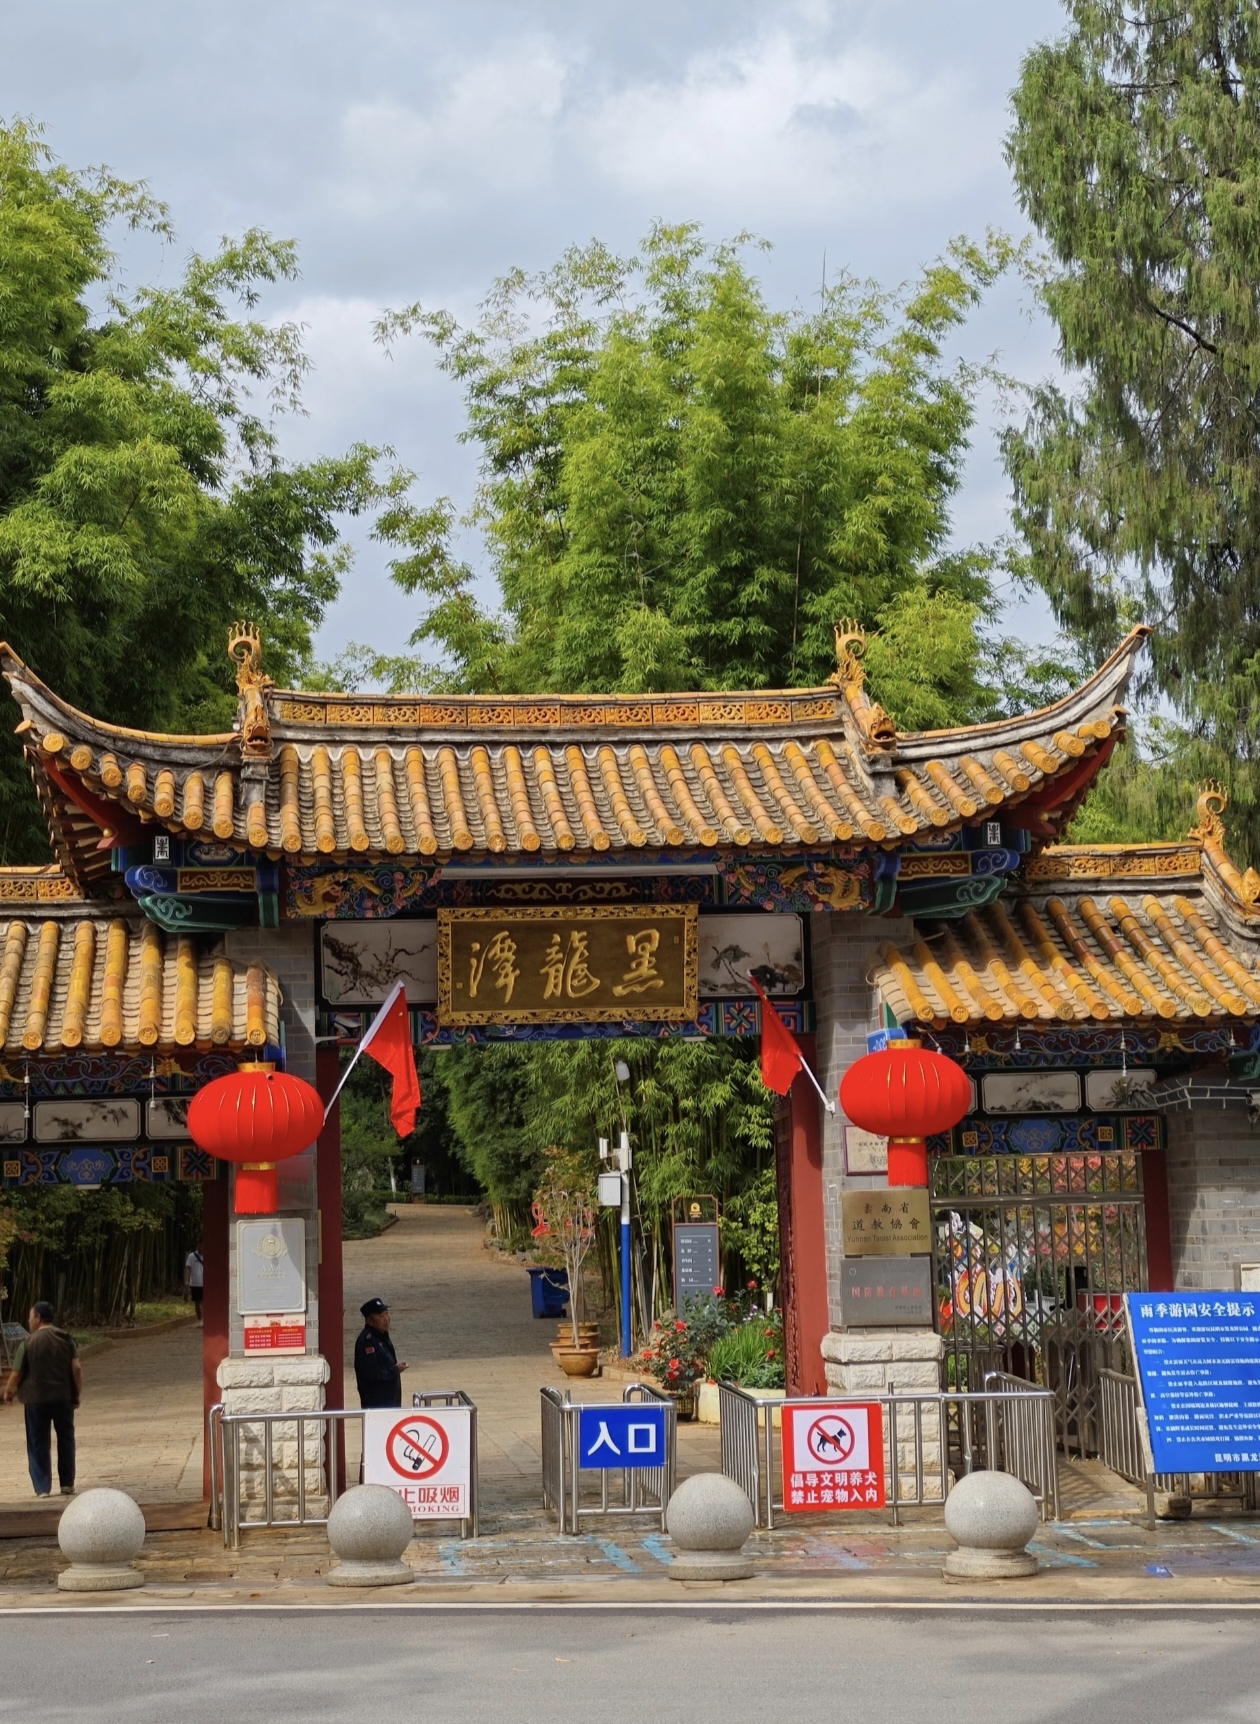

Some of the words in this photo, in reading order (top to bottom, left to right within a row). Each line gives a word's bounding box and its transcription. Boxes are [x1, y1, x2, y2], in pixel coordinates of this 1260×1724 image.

[847, 1235, 871, 1243] Yunnan
[873, 1234, 892, 1242] Taoist
[892, 1233, 928, 1241] Association
[1140, 1302, 1255, 1318] 雨季游园安全提示
[587, 1421, 656, 1456] 入口
[1214, 1453, 1260, 1463] 昆明市黑龙
[790, 1471, 878, 1488] 倡导文明养犬
[398, 1486, 460, 1504] 止吸烟
[791, 1487, 878, 1505] 禁止宠物入内
[410, 1505, 460, 1513] MOKING
